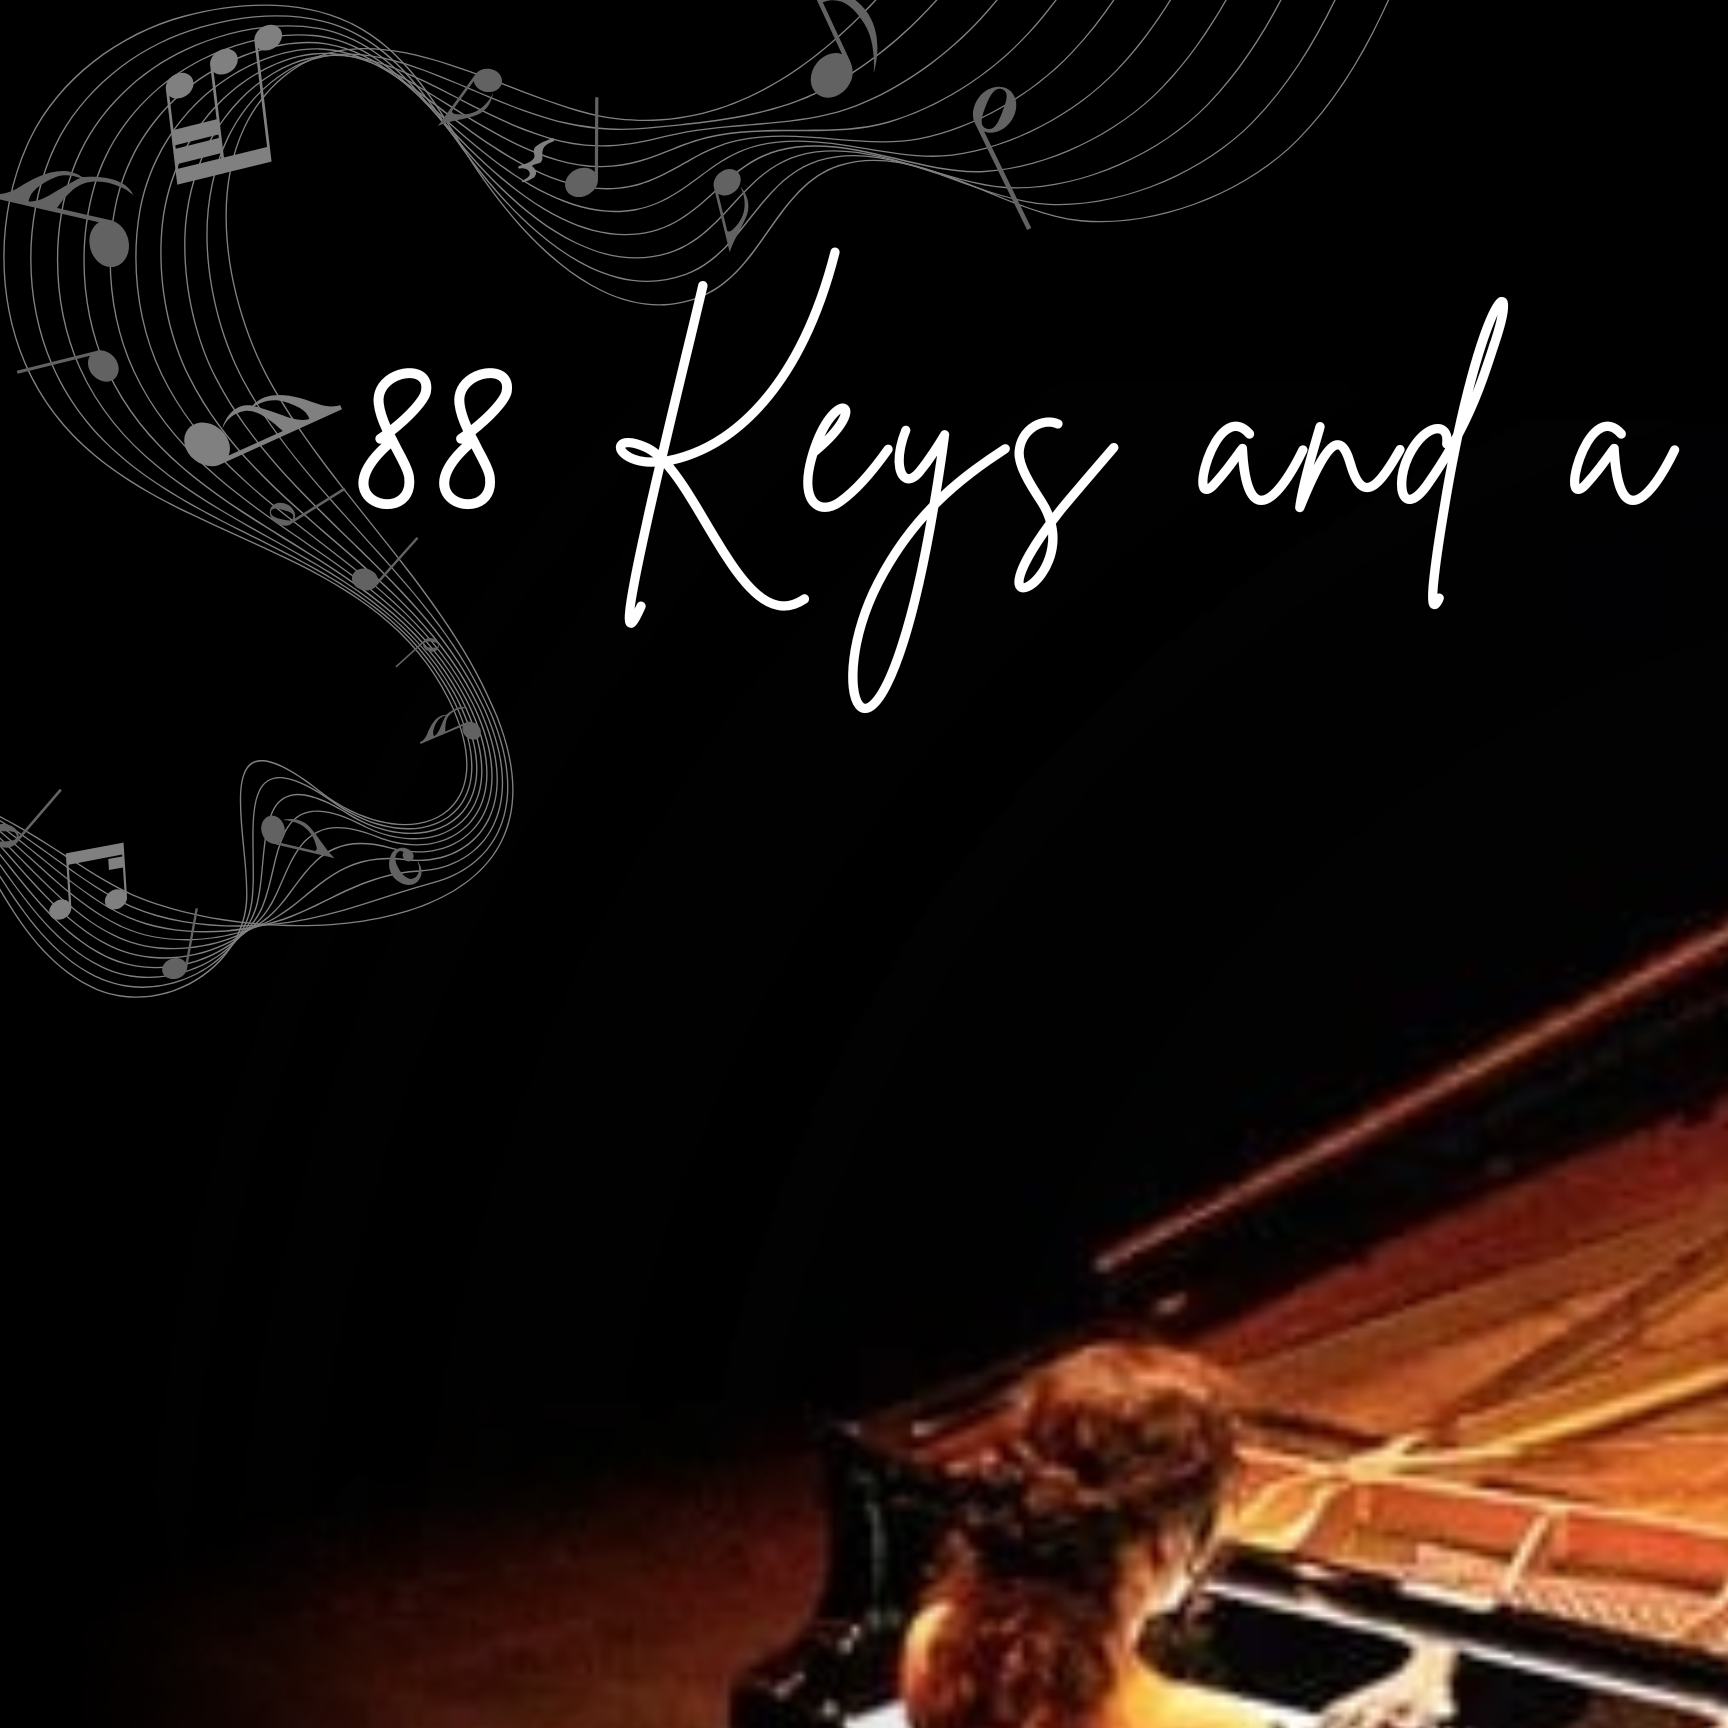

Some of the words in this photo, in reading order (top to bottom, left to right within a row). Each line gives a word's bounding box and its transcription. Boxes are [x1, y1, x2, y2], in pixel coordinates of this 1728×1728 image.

[358, 366, 513, 511] 88
[615, 247, 1120, 714] Keys
[1196, 296, 1510, 611] and
[1568, 420, 1681, 507] a
